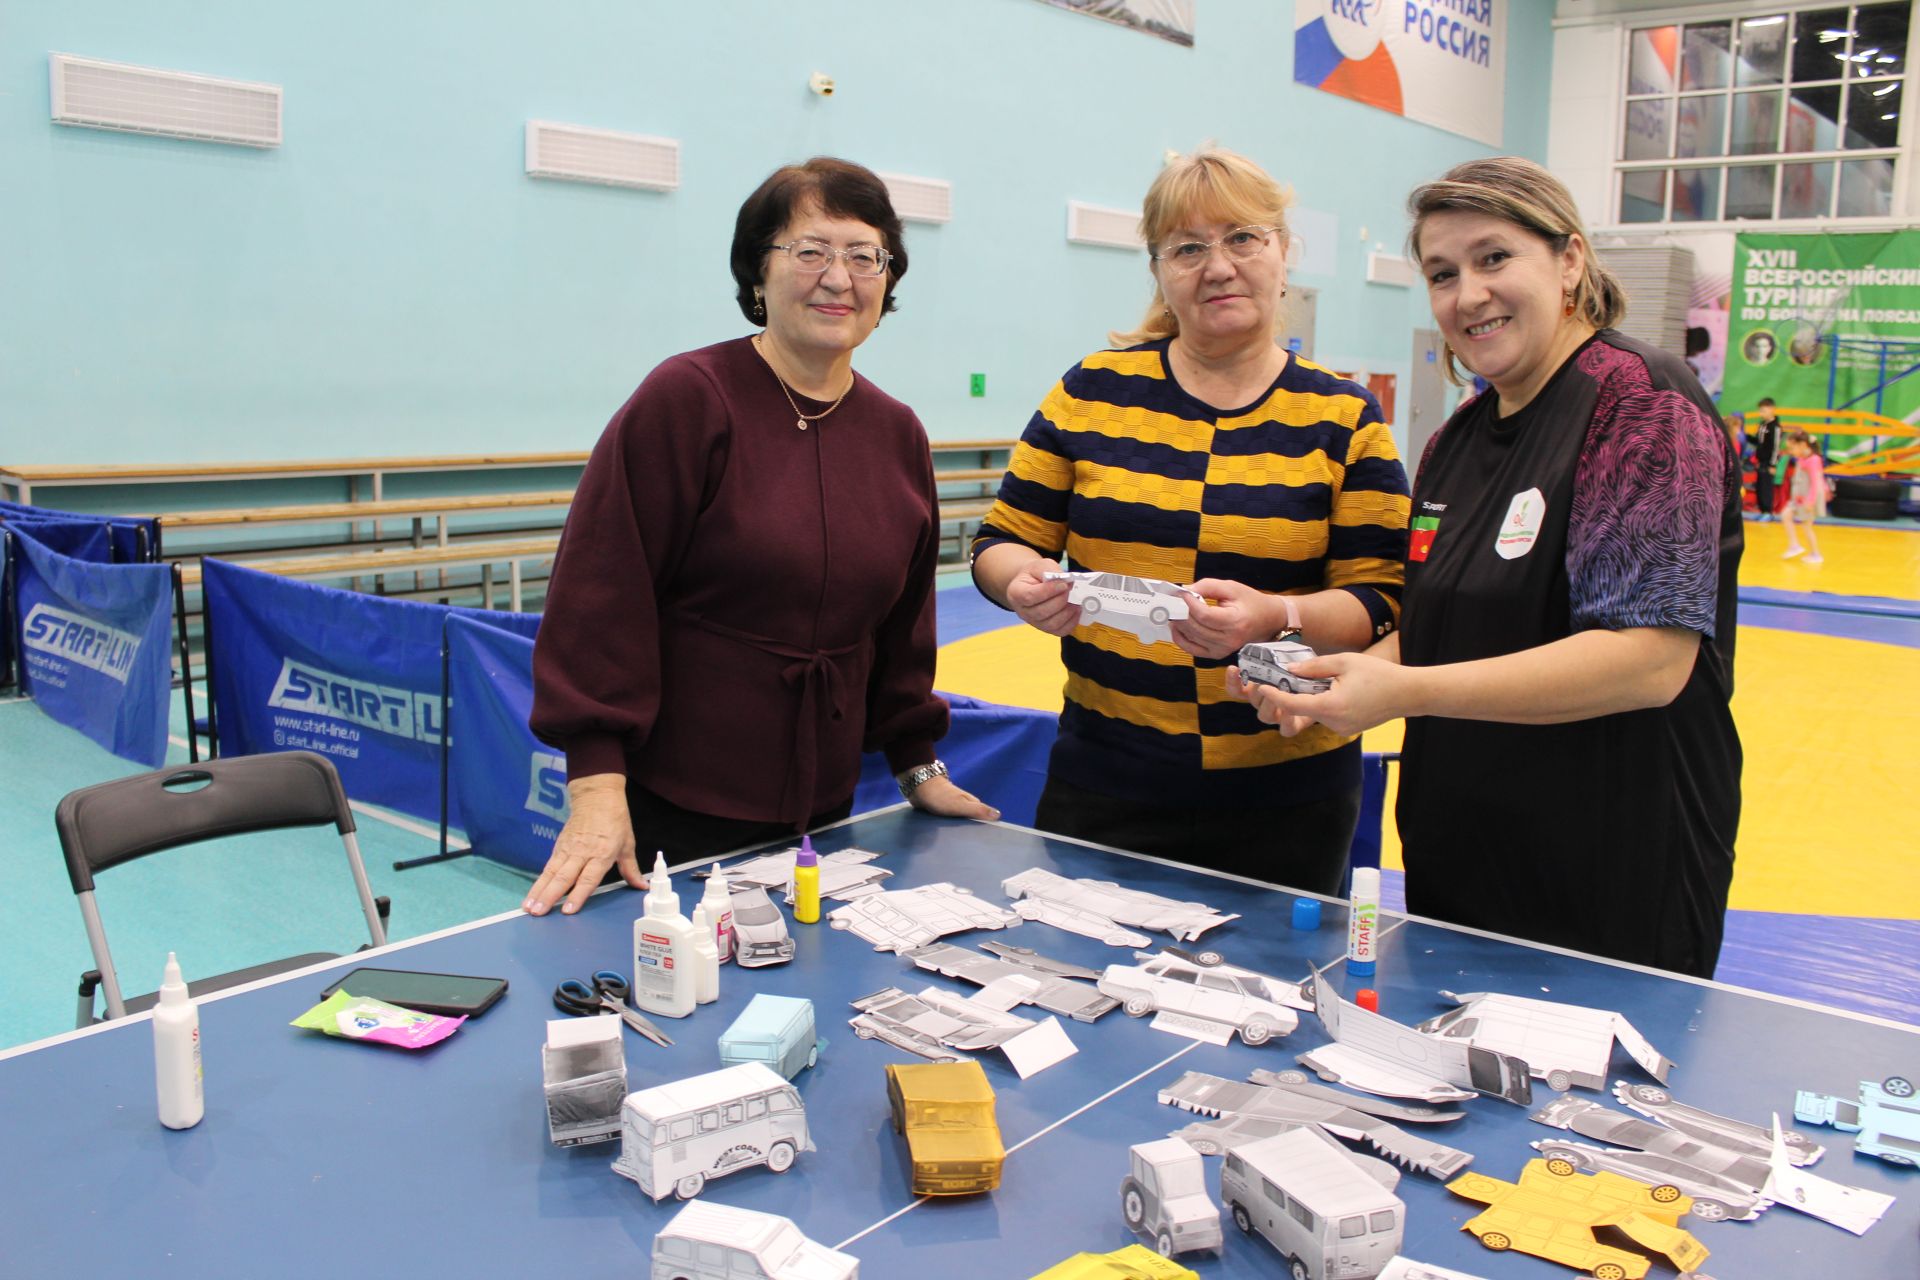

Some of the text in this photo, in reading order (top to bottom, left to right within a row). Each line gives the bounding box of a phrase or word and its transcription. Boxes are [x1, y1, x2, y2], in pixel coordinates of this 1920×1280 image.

[1404, 1, 1491, 68] РОССИЯ
[1747, 249, 1797, 268] XVII
[1743, 264, 1920, 286] ВСЕРОССИЙСКИ
[1742, 308, 1766, 321] ПО
[1839, 309, 1860, 322] НА
[1863, 310, 1920, 325] ПОЯСА
[26, 612, 109, 660] START
[283, 667, 406, 727] START
[273, 716, 360, 742] www.start-line.ru
[1358, 916, 1371, 956] STAFF
[735, 1144, 763, 1156] COAST
